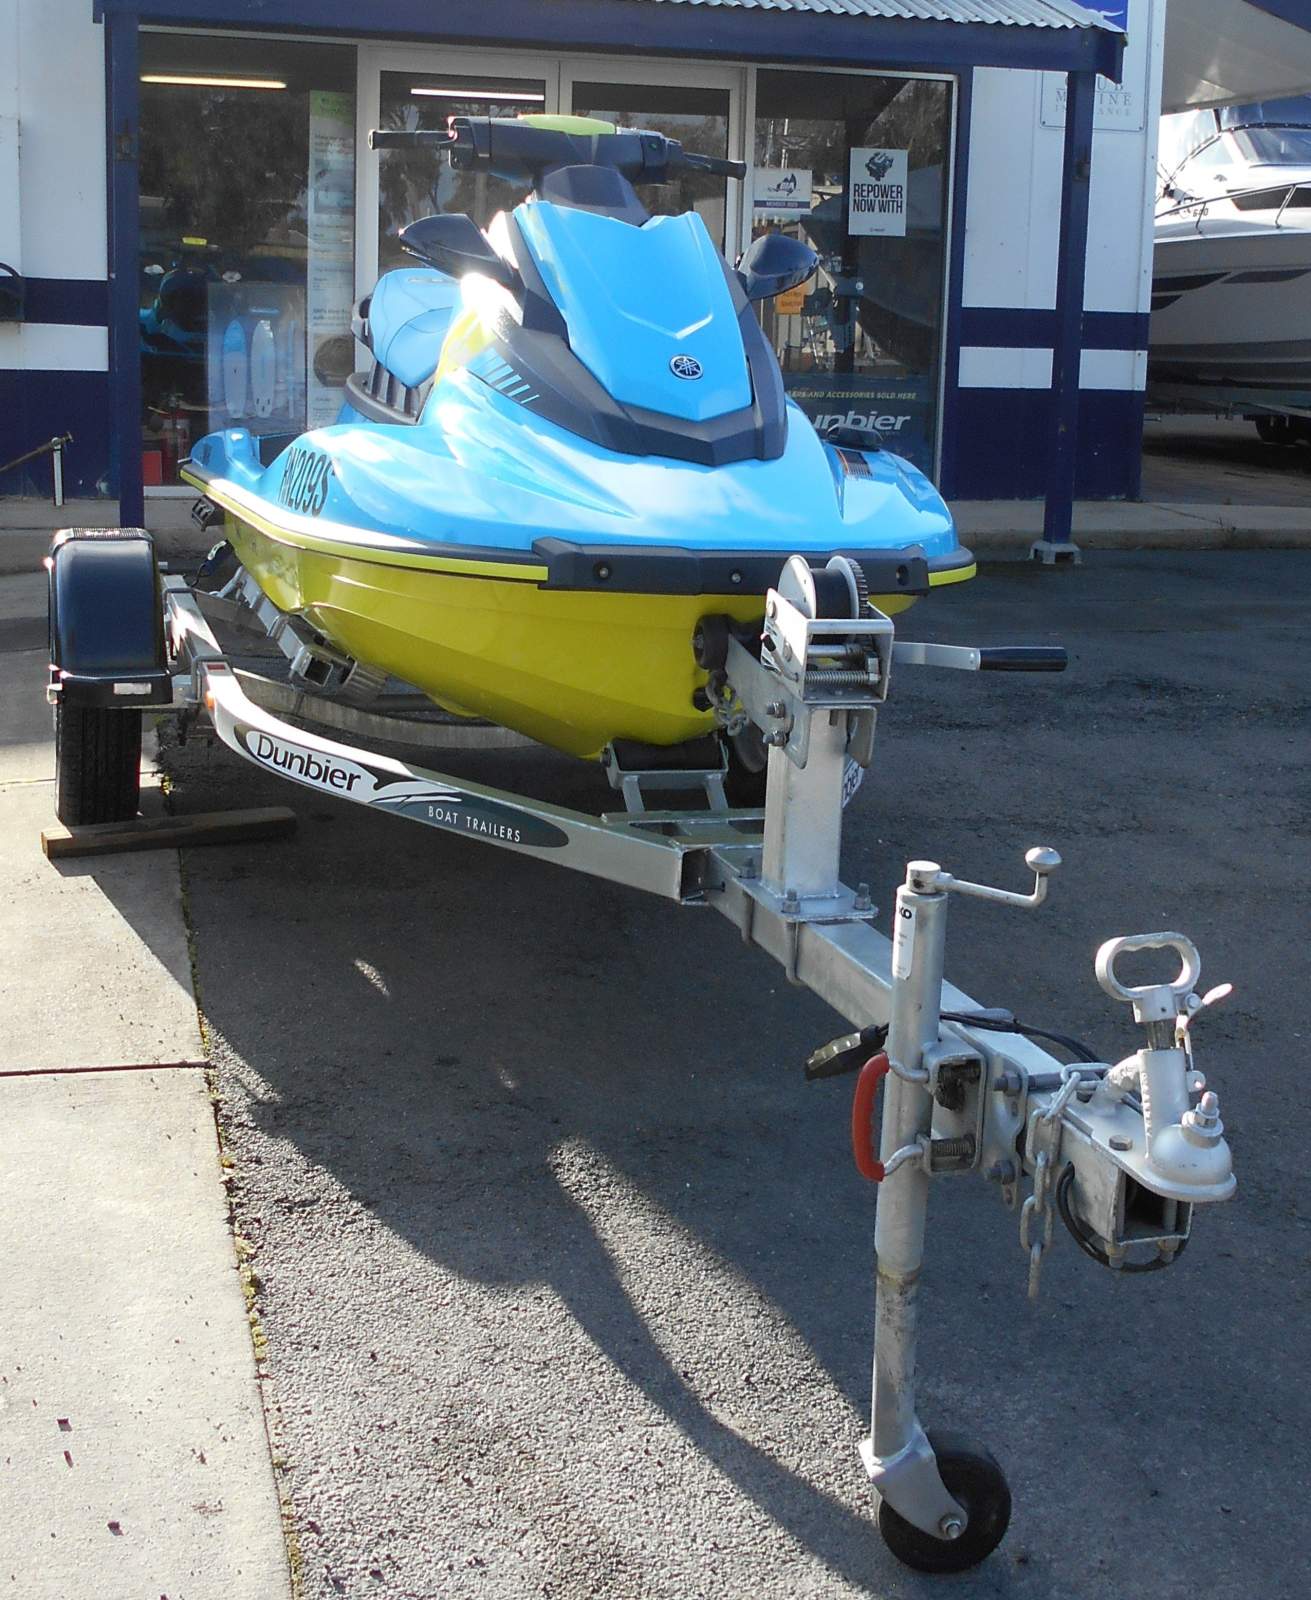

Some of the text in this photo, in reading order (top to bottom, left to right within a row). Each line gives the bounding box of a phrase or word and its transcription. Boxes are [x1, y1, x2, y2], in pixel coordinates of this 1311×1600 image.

[1056, 90, 1132, 106] MINE
[853, 183, 903, 199] REPOWER
[853, 199, 903, 214] NOW WITH
[826, 391, 875, 399] ACCESSORIES
[876, 392, 896, 400] SOLD
[897, 392, 917, 400] HERE
[257, 734, 361, 792] Dunbier
[428, 805, 521, 842] BOAT TRAILERS
